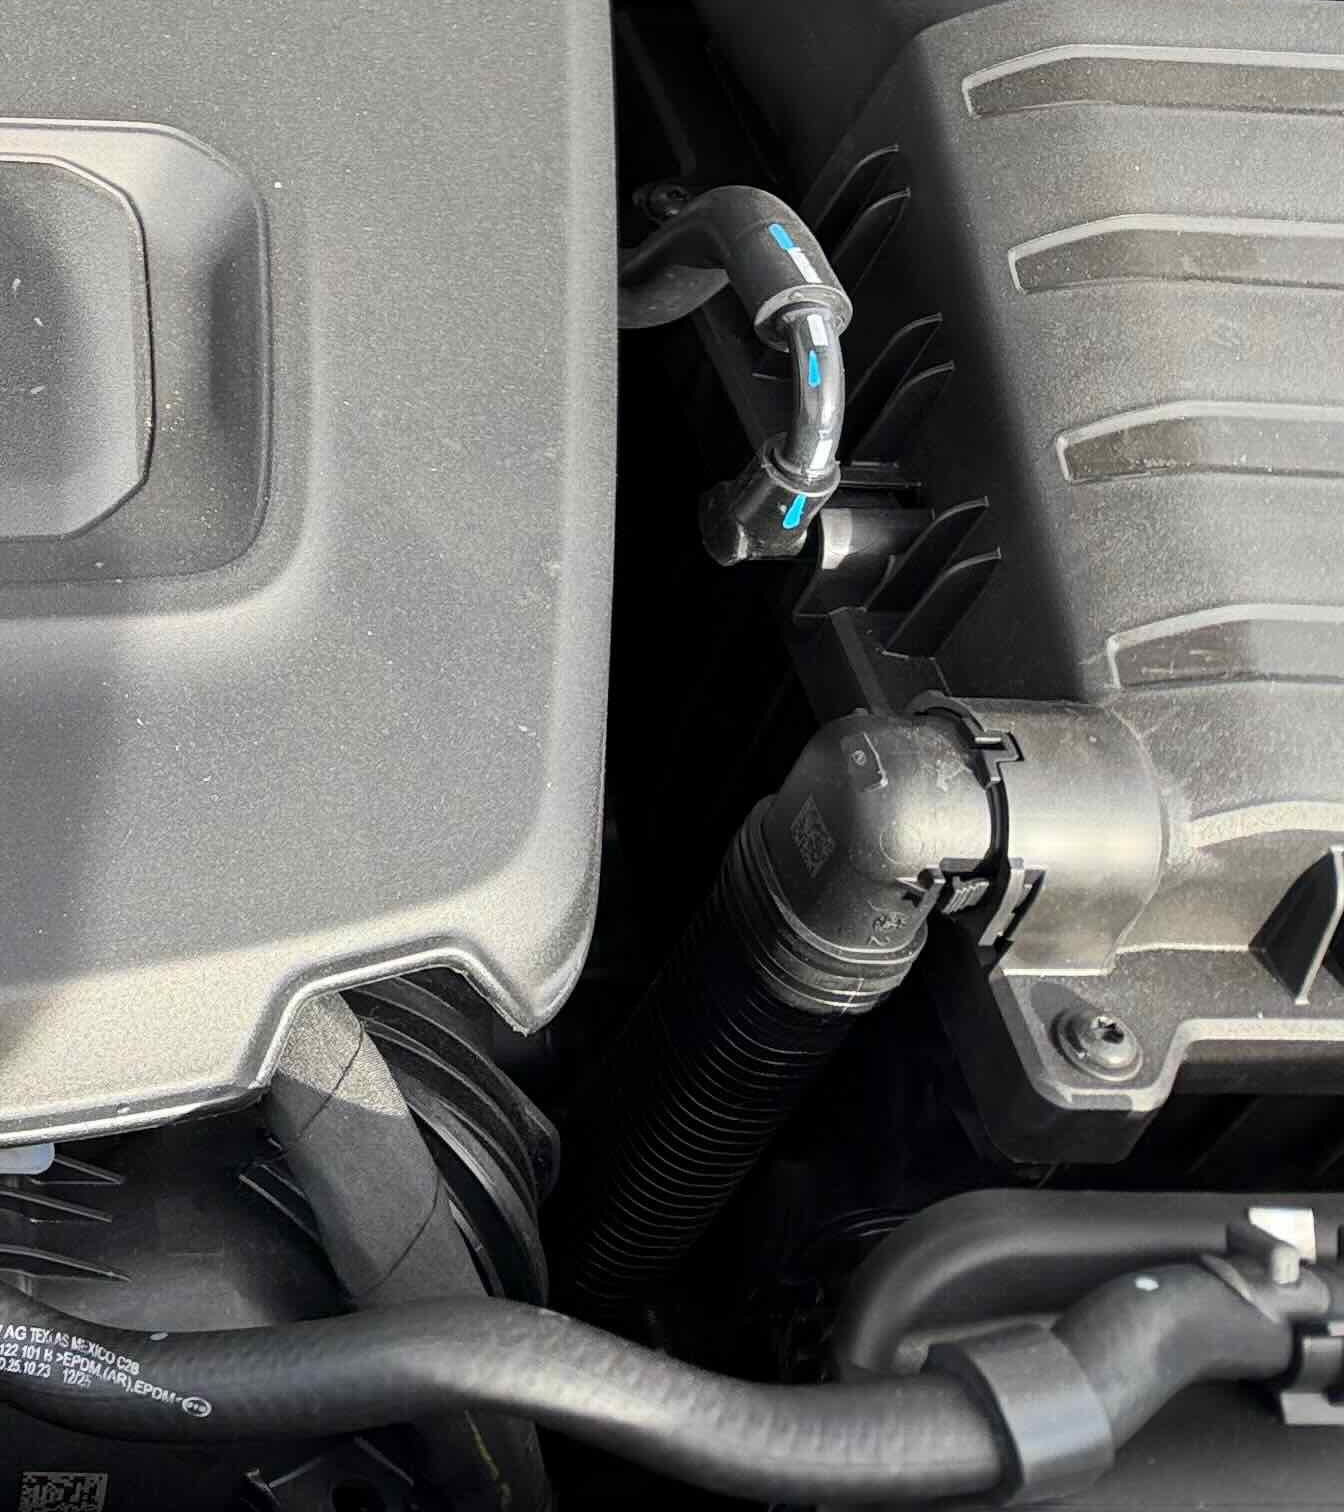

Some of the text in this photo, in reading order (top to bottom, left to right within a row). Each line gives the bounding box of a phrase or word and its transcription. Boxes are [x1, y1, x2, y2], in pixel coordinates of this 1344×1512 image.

[0, 1342, 19, 1358] 122
[21, 1344, 40, 1361] 101
[3, 1324, 27, 1341] AG
[71, 1335, 115, 1365] MEXICO
